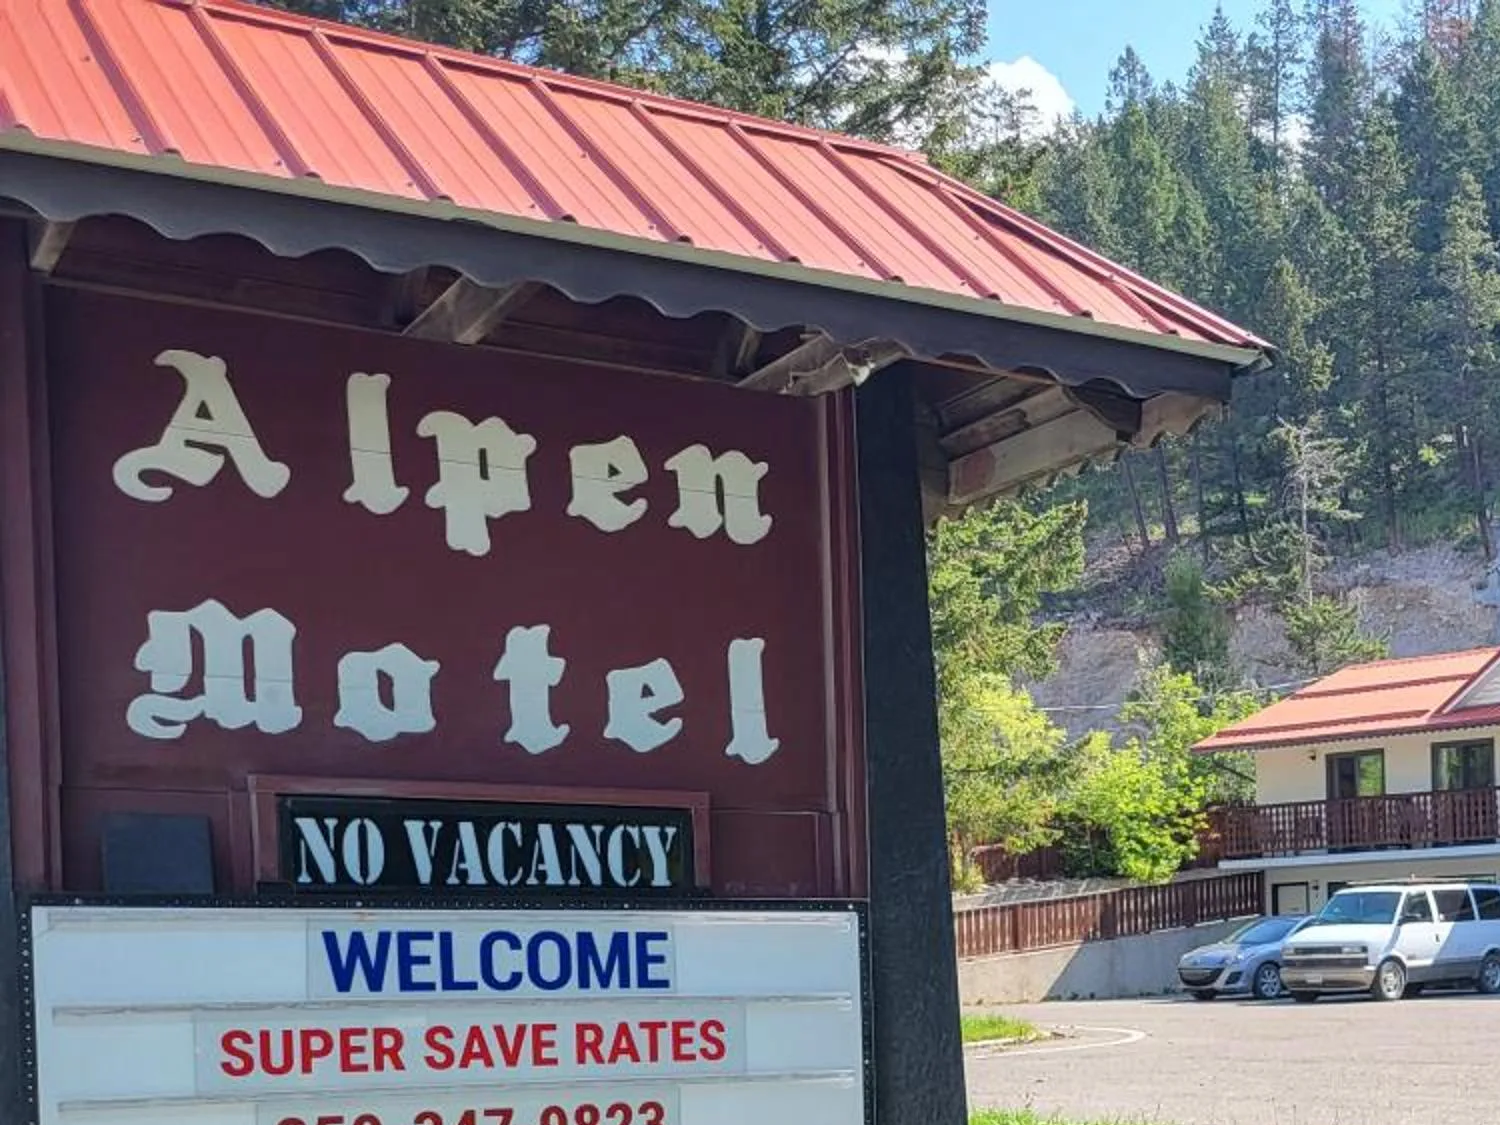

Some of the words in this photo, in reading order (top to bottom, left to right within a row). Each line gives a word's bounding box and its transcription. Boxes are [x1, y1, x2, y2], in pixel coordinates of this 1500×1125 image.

[113, 349, 773, 556] Alpen
[126, 599, 780, 765] Motel
[295, 817, 384, 883] NO
[403, 820, 677, 886] VACANCY
[320, 930, 671, 993] WELCOME
[220, 1028, 406, 1076] SUPER
[424, 1022, 559, 1069] SAVE
[575, 1020, 727, 1064] RATES
